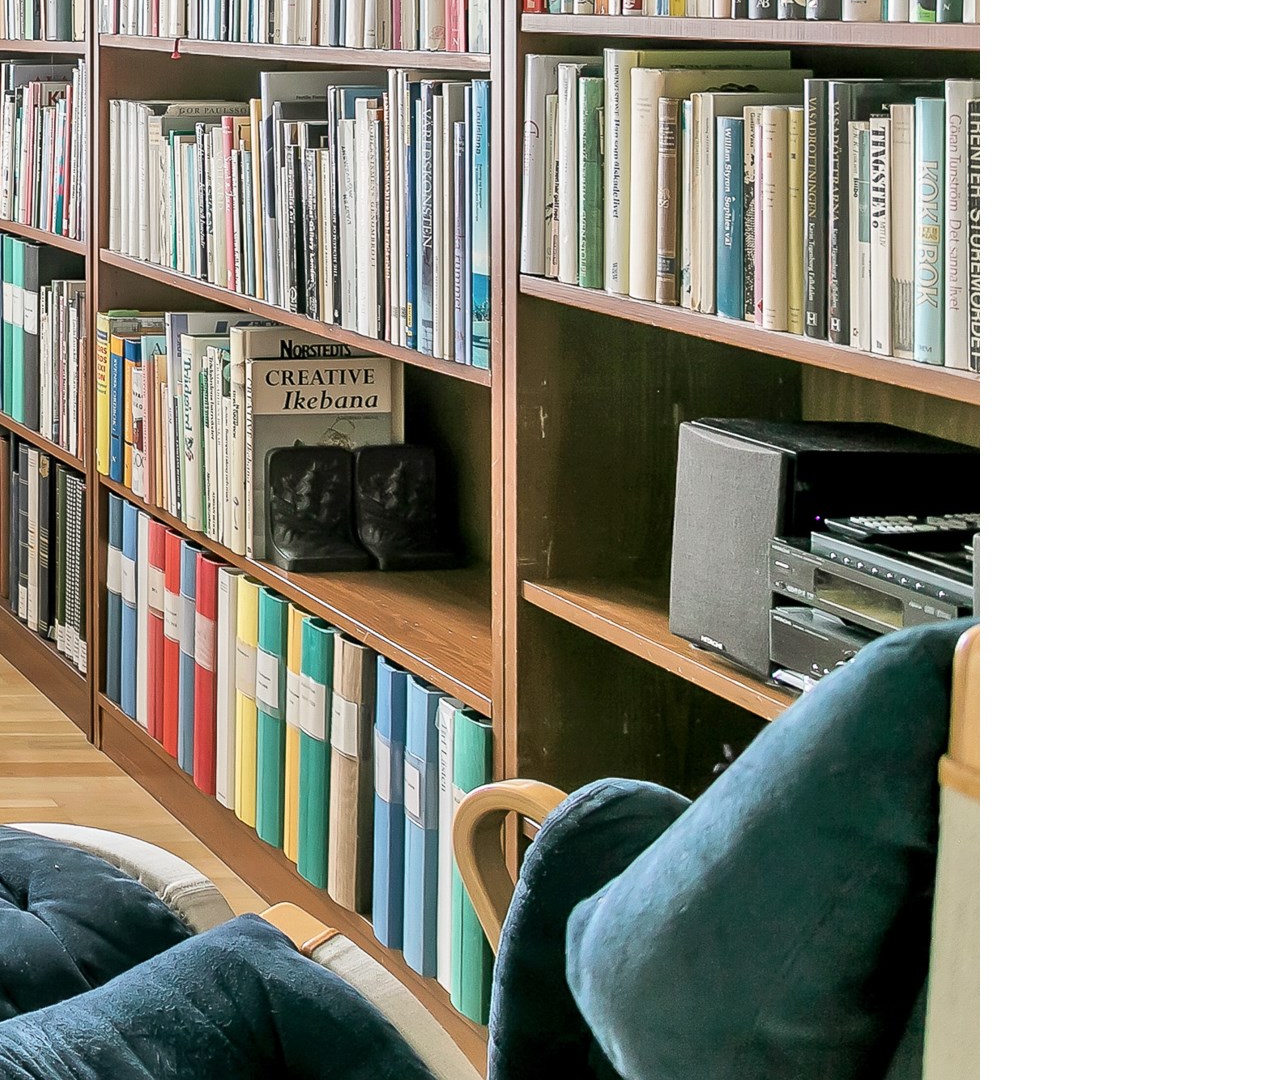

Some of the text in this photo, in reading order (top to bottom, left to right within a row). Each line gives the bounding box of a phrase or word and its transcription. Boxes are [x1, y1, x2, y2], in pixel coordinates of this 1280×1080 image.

[475, 105, 483, 156] Louisiana
[723, 128, 733, 161] William
[422, 108, 434, 249] VÄRLDSKONSTEN
[722, 163, 733, 192] Styron
[808, 96, 818, 219] VASADROTTNINGEN
[611, 197, 621, 219] livet
[918, 159, 940, 223] KOK
[948, 113, 963, 312] Göran Tunström Det sanna livet
[723, 232, 733, 247] val
[915, 242, 939, 309] BOK
[279, 340, 352, 358] NORSTEDTS
[182, 357, 193, 432] Trädgård
[265, 369, 376, 387] CREATIVE
[282, 390, 379, 410] Ikebana
